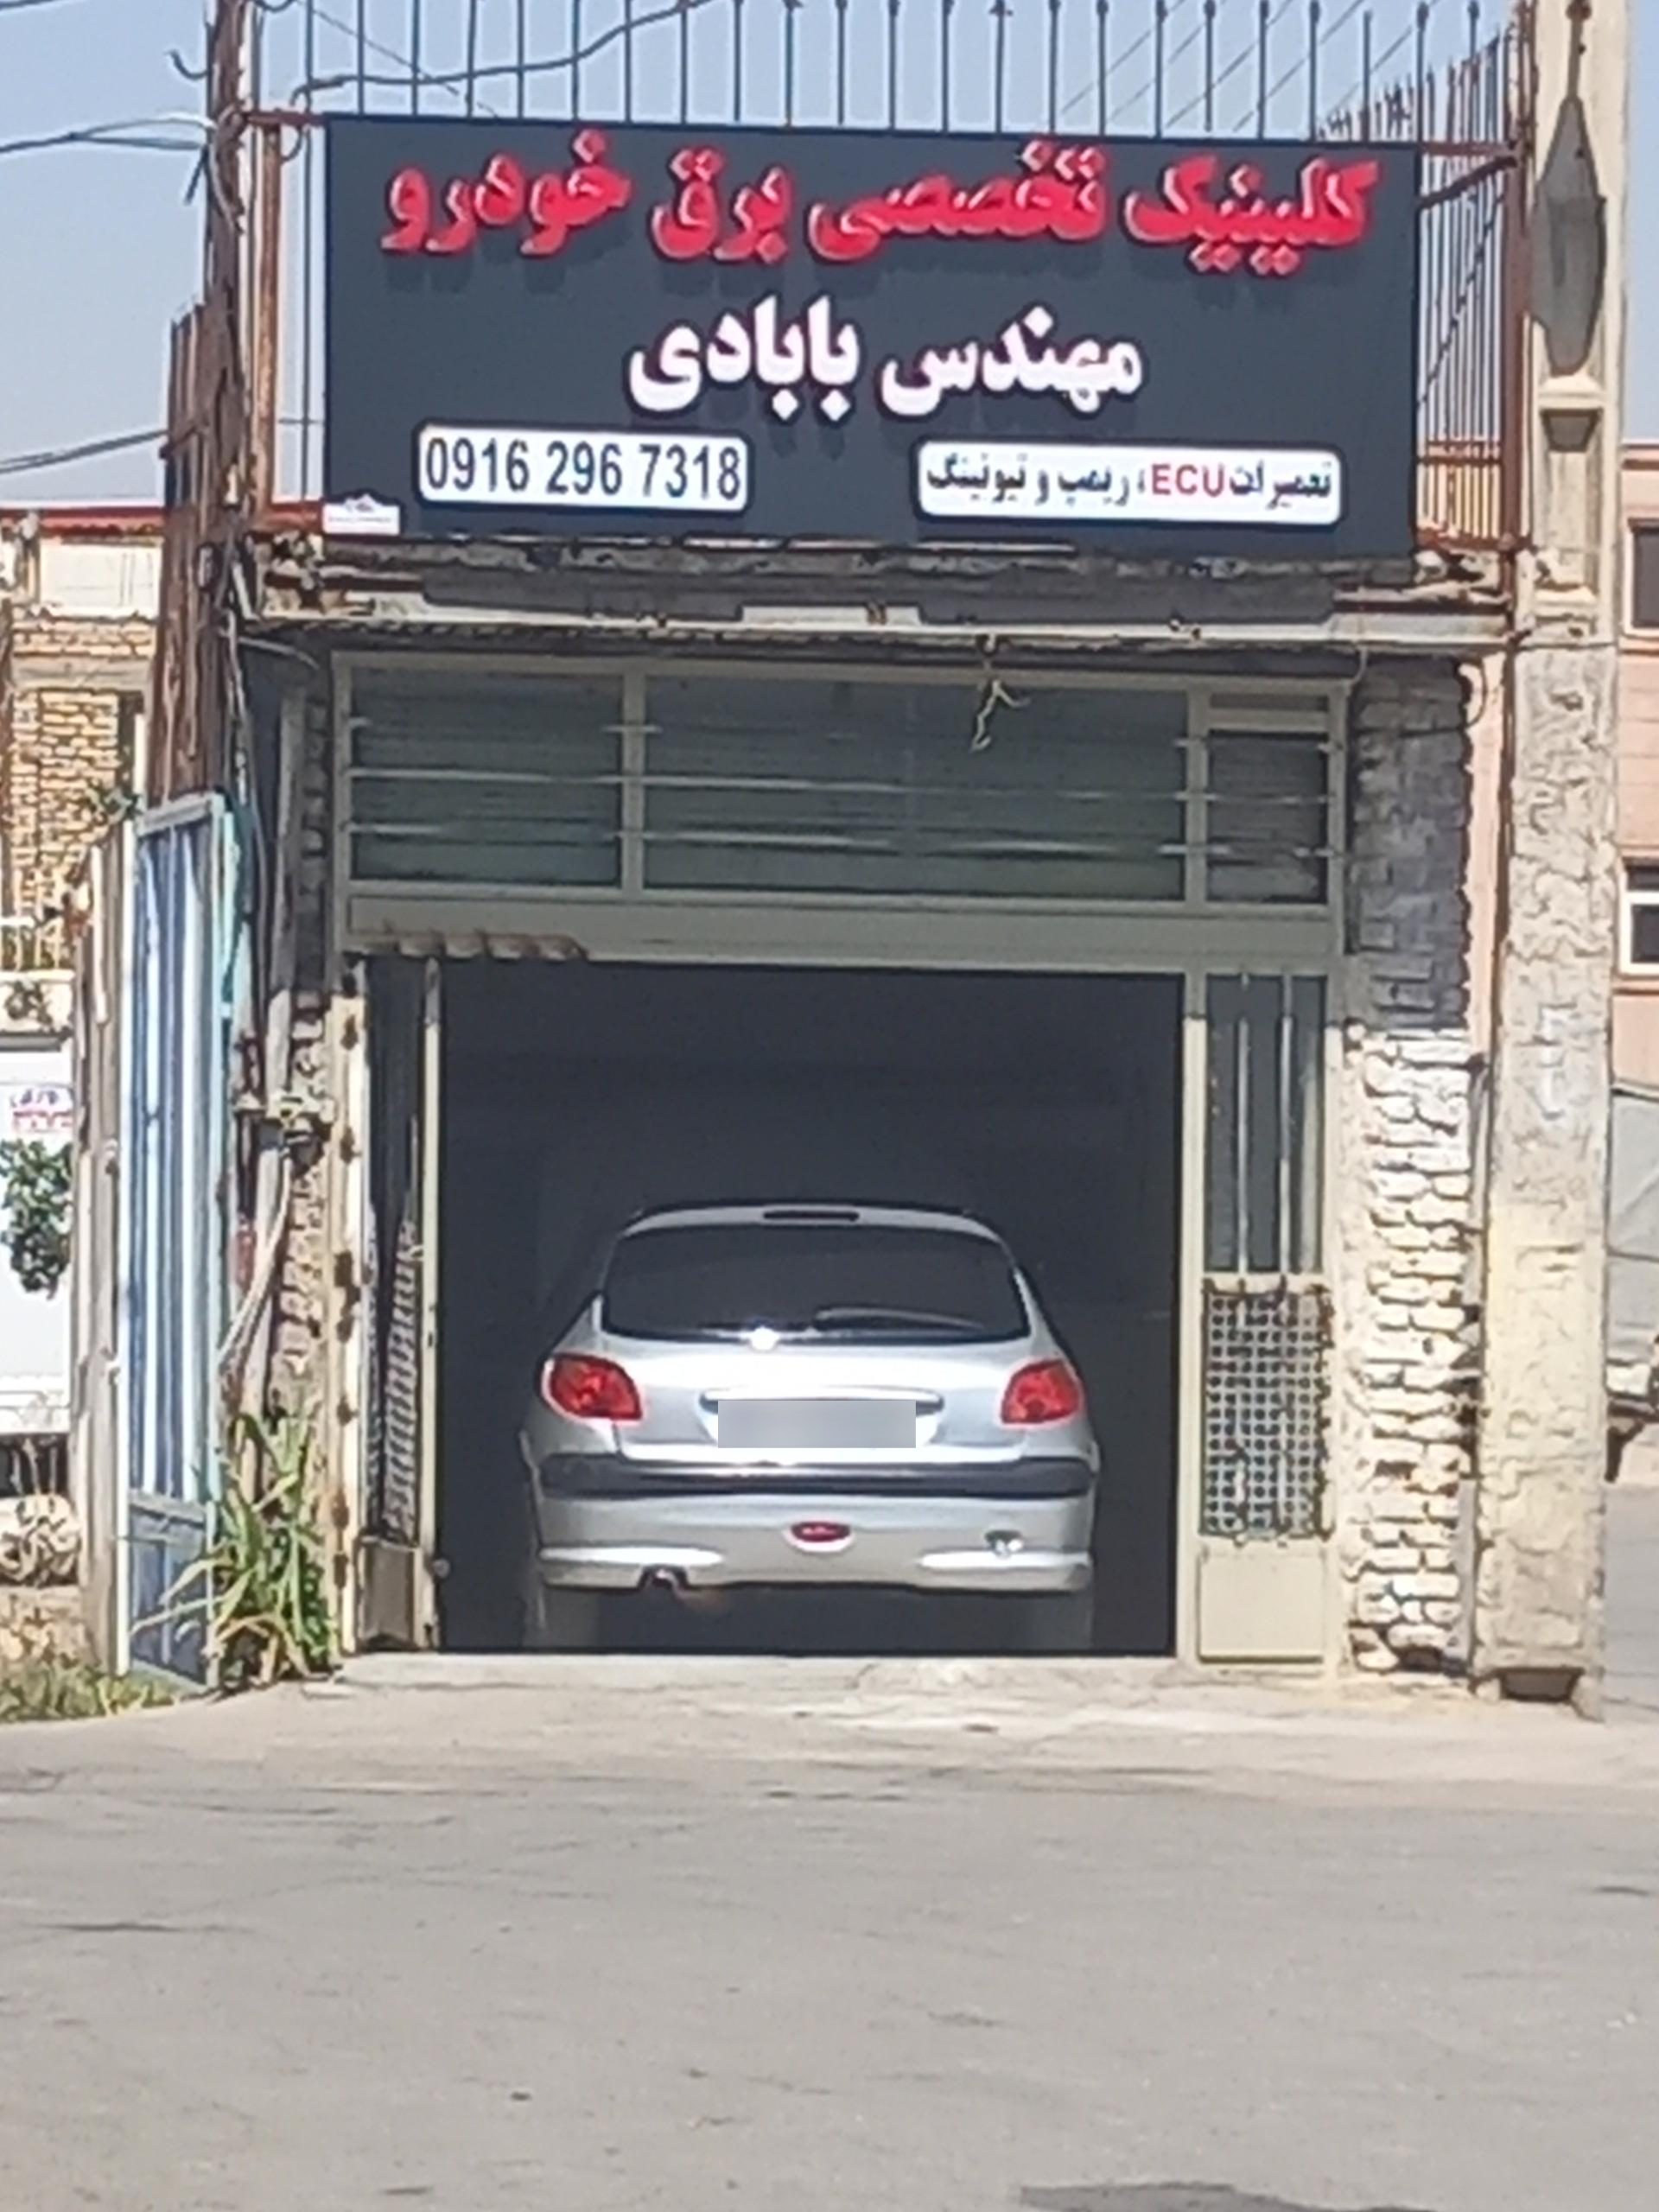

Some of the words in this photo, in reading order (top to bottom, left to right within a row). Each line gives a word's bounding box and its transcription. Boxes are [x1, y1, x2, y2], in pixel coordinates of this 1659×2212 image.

[380, 128, 632, 257] خودرو
[651, 147, 792, 264] برق
[809, 138, 1107, 263] تخصصی
[1124, 155, 1379, 275] کلینیک
[629, 295, 860, 423] بابادی
[880, 306, 1143, 416] مهندس
[426, 437, 531, 491] 0916
[545, 441, 624, 496] 296
[638, 443, 741, 500] 7318
[1034, 470, 1050, 505] و
[1230, 460, 1332, 510] تعمیرات
